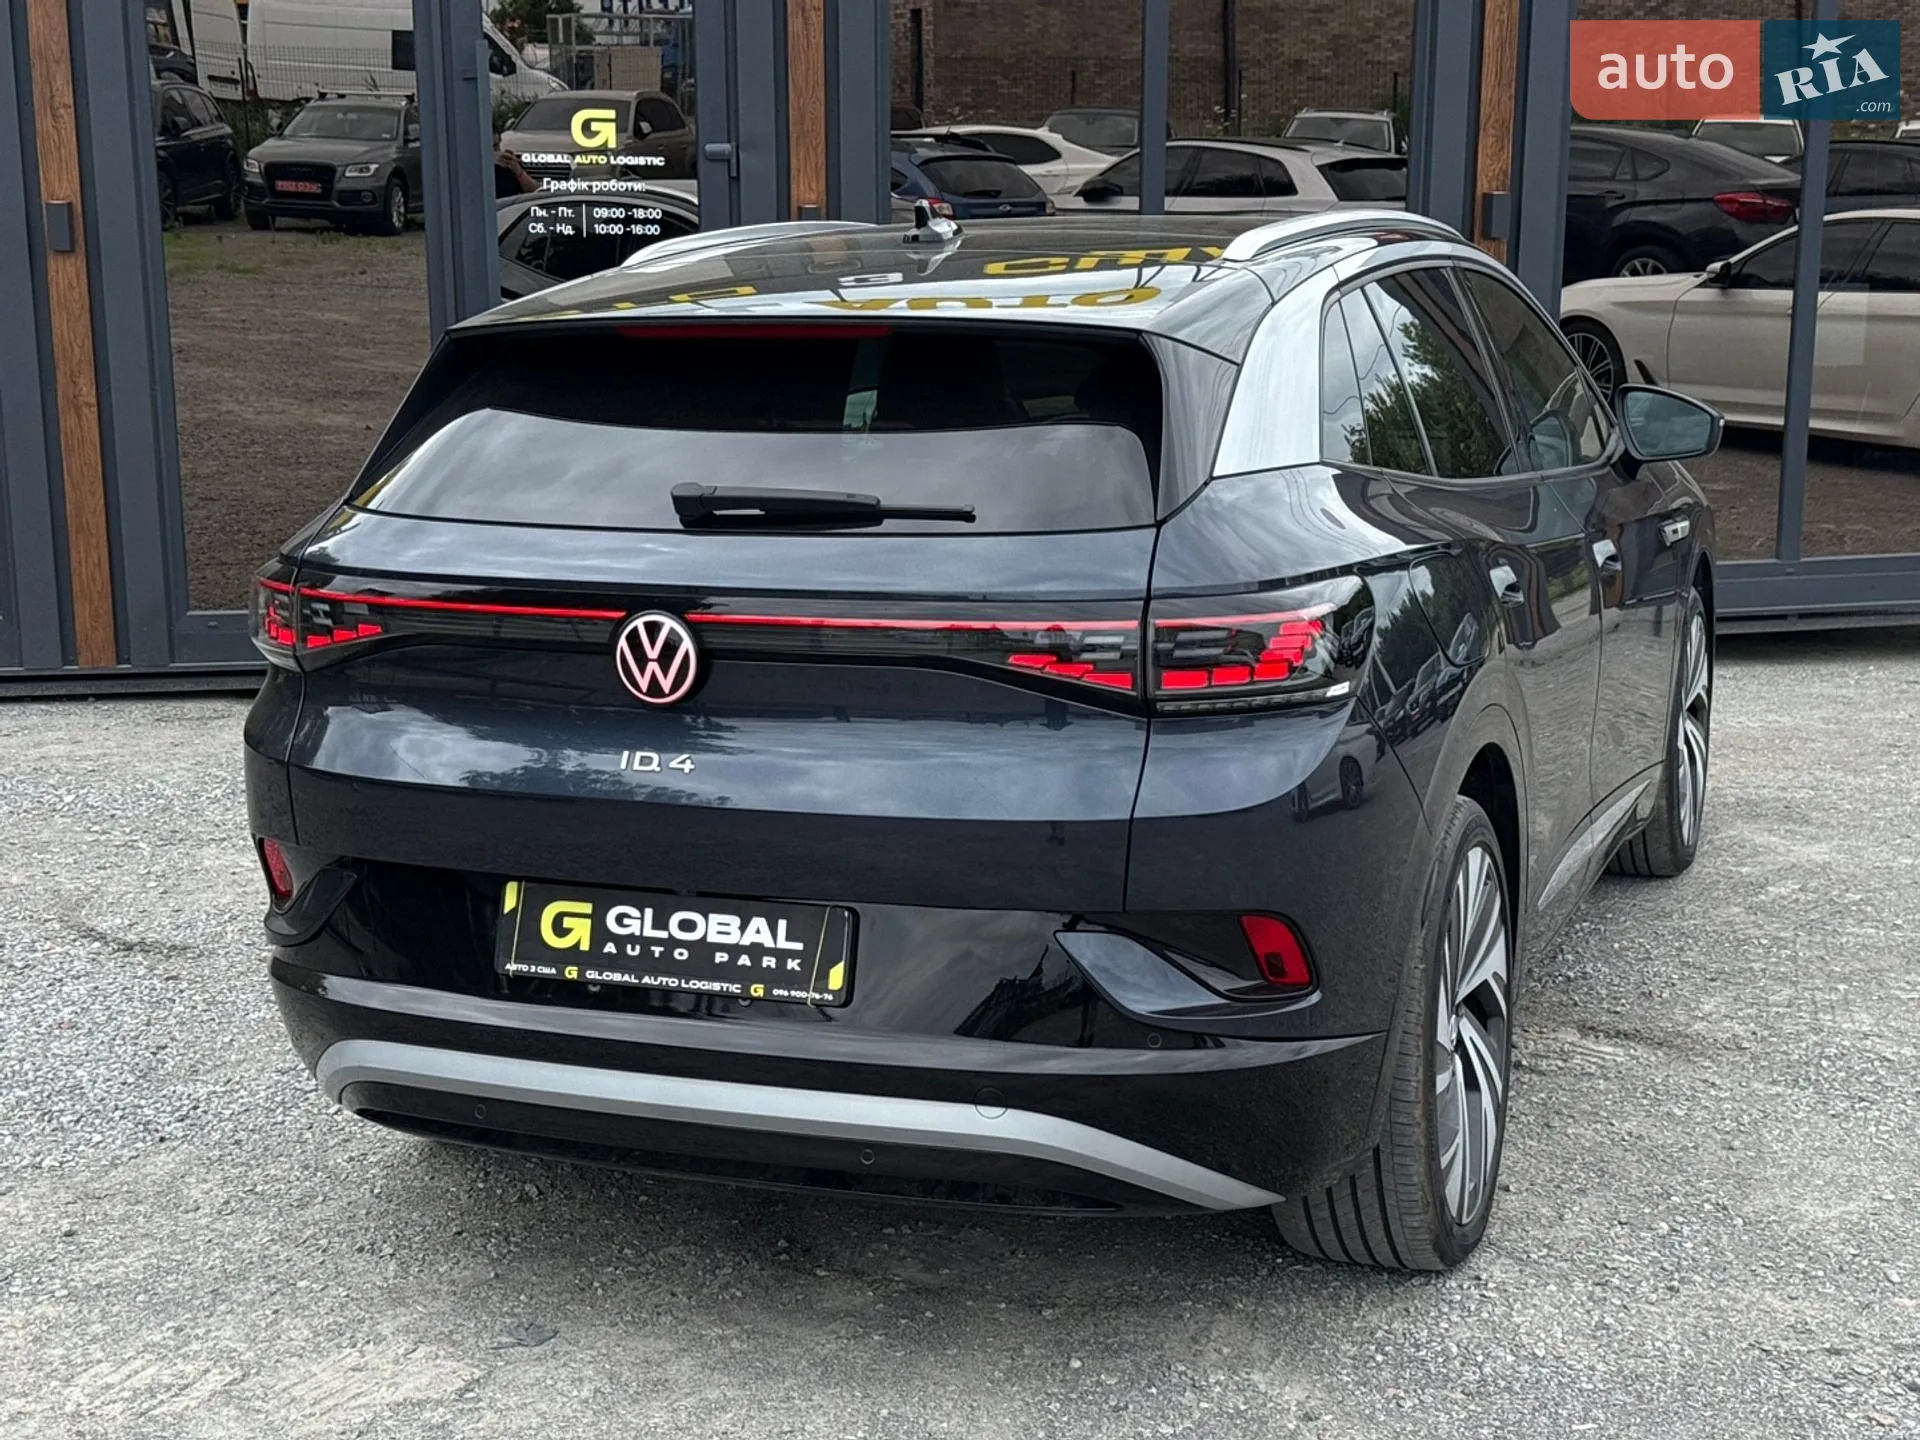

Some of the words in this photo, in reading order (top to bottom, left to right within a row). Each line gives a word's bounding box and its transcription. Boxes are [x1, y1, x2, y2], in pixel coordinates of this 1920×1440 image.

[521, 153, 571, 164] GLOBAL
[574, 154, 608, 165] AUTO
[609, 155, 666, 166] LOGISTIC
[542, 177, 590, 193] Графік
[592, 178, 647, 193] роботи:
[530, 206, 549, 218] Пн.
[558, 206, 576, 218] Пт.
[593, 207, 626, 219] 09:00
[528, 222, 548, 234] Сб.
[593, 223, 625, 235] 10:00
[616, 614, 697, 704] VW
[605, 904, 804, 951] GLOBAL
[602, 941, 690, 961] AUTO
[714, 952, 802, 972] PARK
[536, 965, 557, 975] США
[585, 969, 640, 984] GLOBAL
[641, 975, 680, 988] AUTO
[680, 978, 742, 994] LOGISTIC
